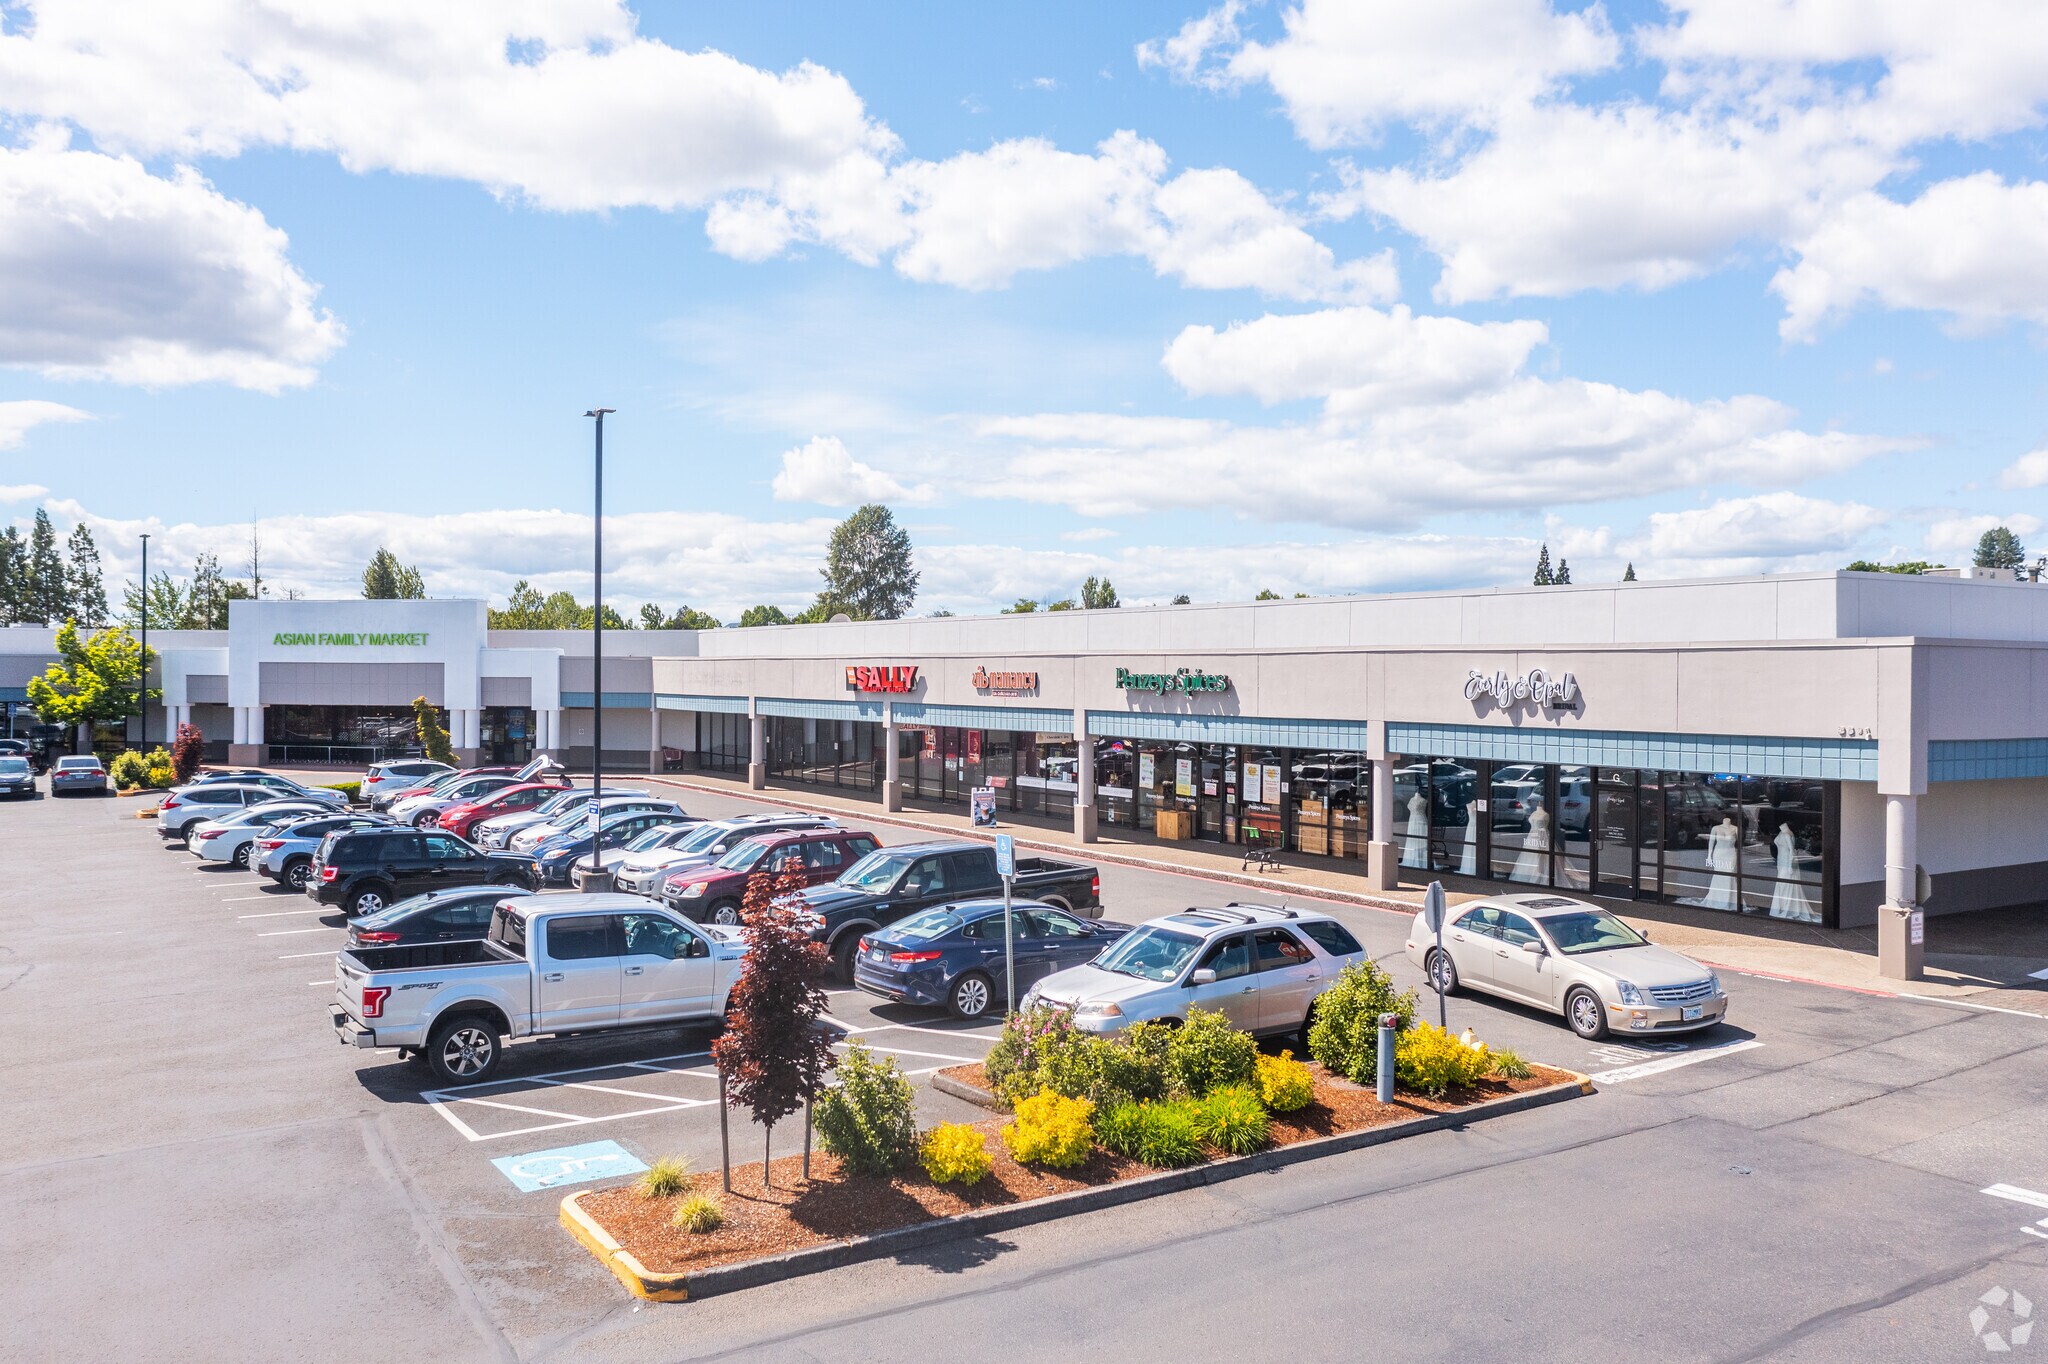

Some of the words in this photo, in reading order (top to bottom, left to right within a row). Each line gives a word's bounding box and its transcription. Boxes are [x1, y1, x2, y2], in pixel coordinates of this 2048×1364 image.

[273, 633, 315, 646] ASIAN
[318, 633, 367, 646] FAMILY
[369, 633, 429, 646] MARKET
[856, 666, 916, 688] SALLY
[1115, 667, 1175, 697] Penzeys
[1176, 667, 1227, 698] Spices
[1464, 670, 1513, 708] Everly
[1529, 668, 1577, 708] Opal
[1612, 773, 1621, 783] G
[398, 981, 444, 991] SPORT
